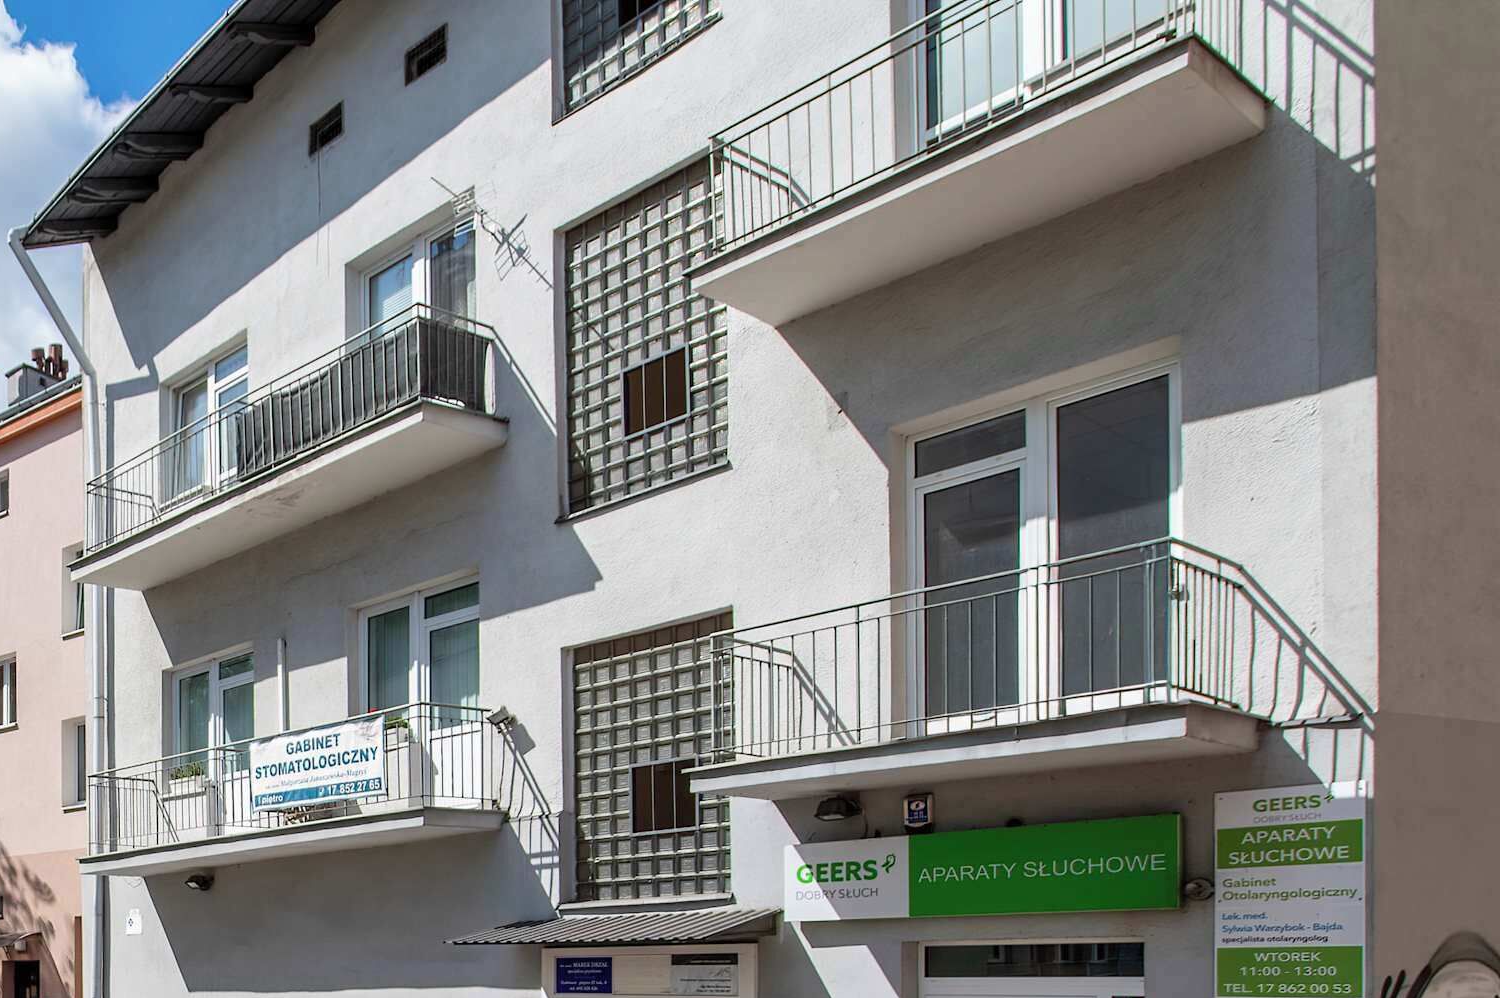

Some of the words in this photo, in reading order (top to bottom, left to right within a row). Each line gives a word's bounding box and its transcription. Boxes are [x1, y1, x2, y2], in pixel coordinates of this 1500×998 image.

[286, 733, 341, 755] GABINET
[255, 747, 378, 779] STOMATOLOGICZNY
[261, 794, 283, 806] piętro
[327, 785, 337, 796] 17
[340, 783, 355, 793] 852
[357, 781, 367, 791] 27
[369, 779, 380, 790] 65
[1252, 795, 1322, 812] GEERS
[1241, 826, 1336, 845] APARATY
[1228, 846, 1349, 865] SŁUCHOWE
[796, 860, 878, 884] GEERS
[917, 862, 1016, 884] APARATY
[1023, 853, 1167, 878] SŁUCHOWE
[1222, 877, 1277, 888] Gabinet
[796, 889, 837, 901] DOBRY
[838, 887, 879, 899] SŁUCH
[1222, 887, 1358, 901] Otolaryngologiczny
[1243, 911, 1268, 920] med.
[1222, 924, 1253, 934] Sylwia
[1312, 921, 1343, 932] Bajda
[1222, 935, 1265, 944] specjalista
[1266, 934, 1329, 944] otolaryngolog
[1254, 952, 1321, 962] WTOREK
[1240, 966, 1281, 976] 11:00
[1294, 966, 1337, 976] 13:00
[1257, 984, 1273, 994] 17
[1278, 983, 1306, 994] 862
[1309, 984, 1329, 994] 00
[1332, 984, 1352, 994] 53
